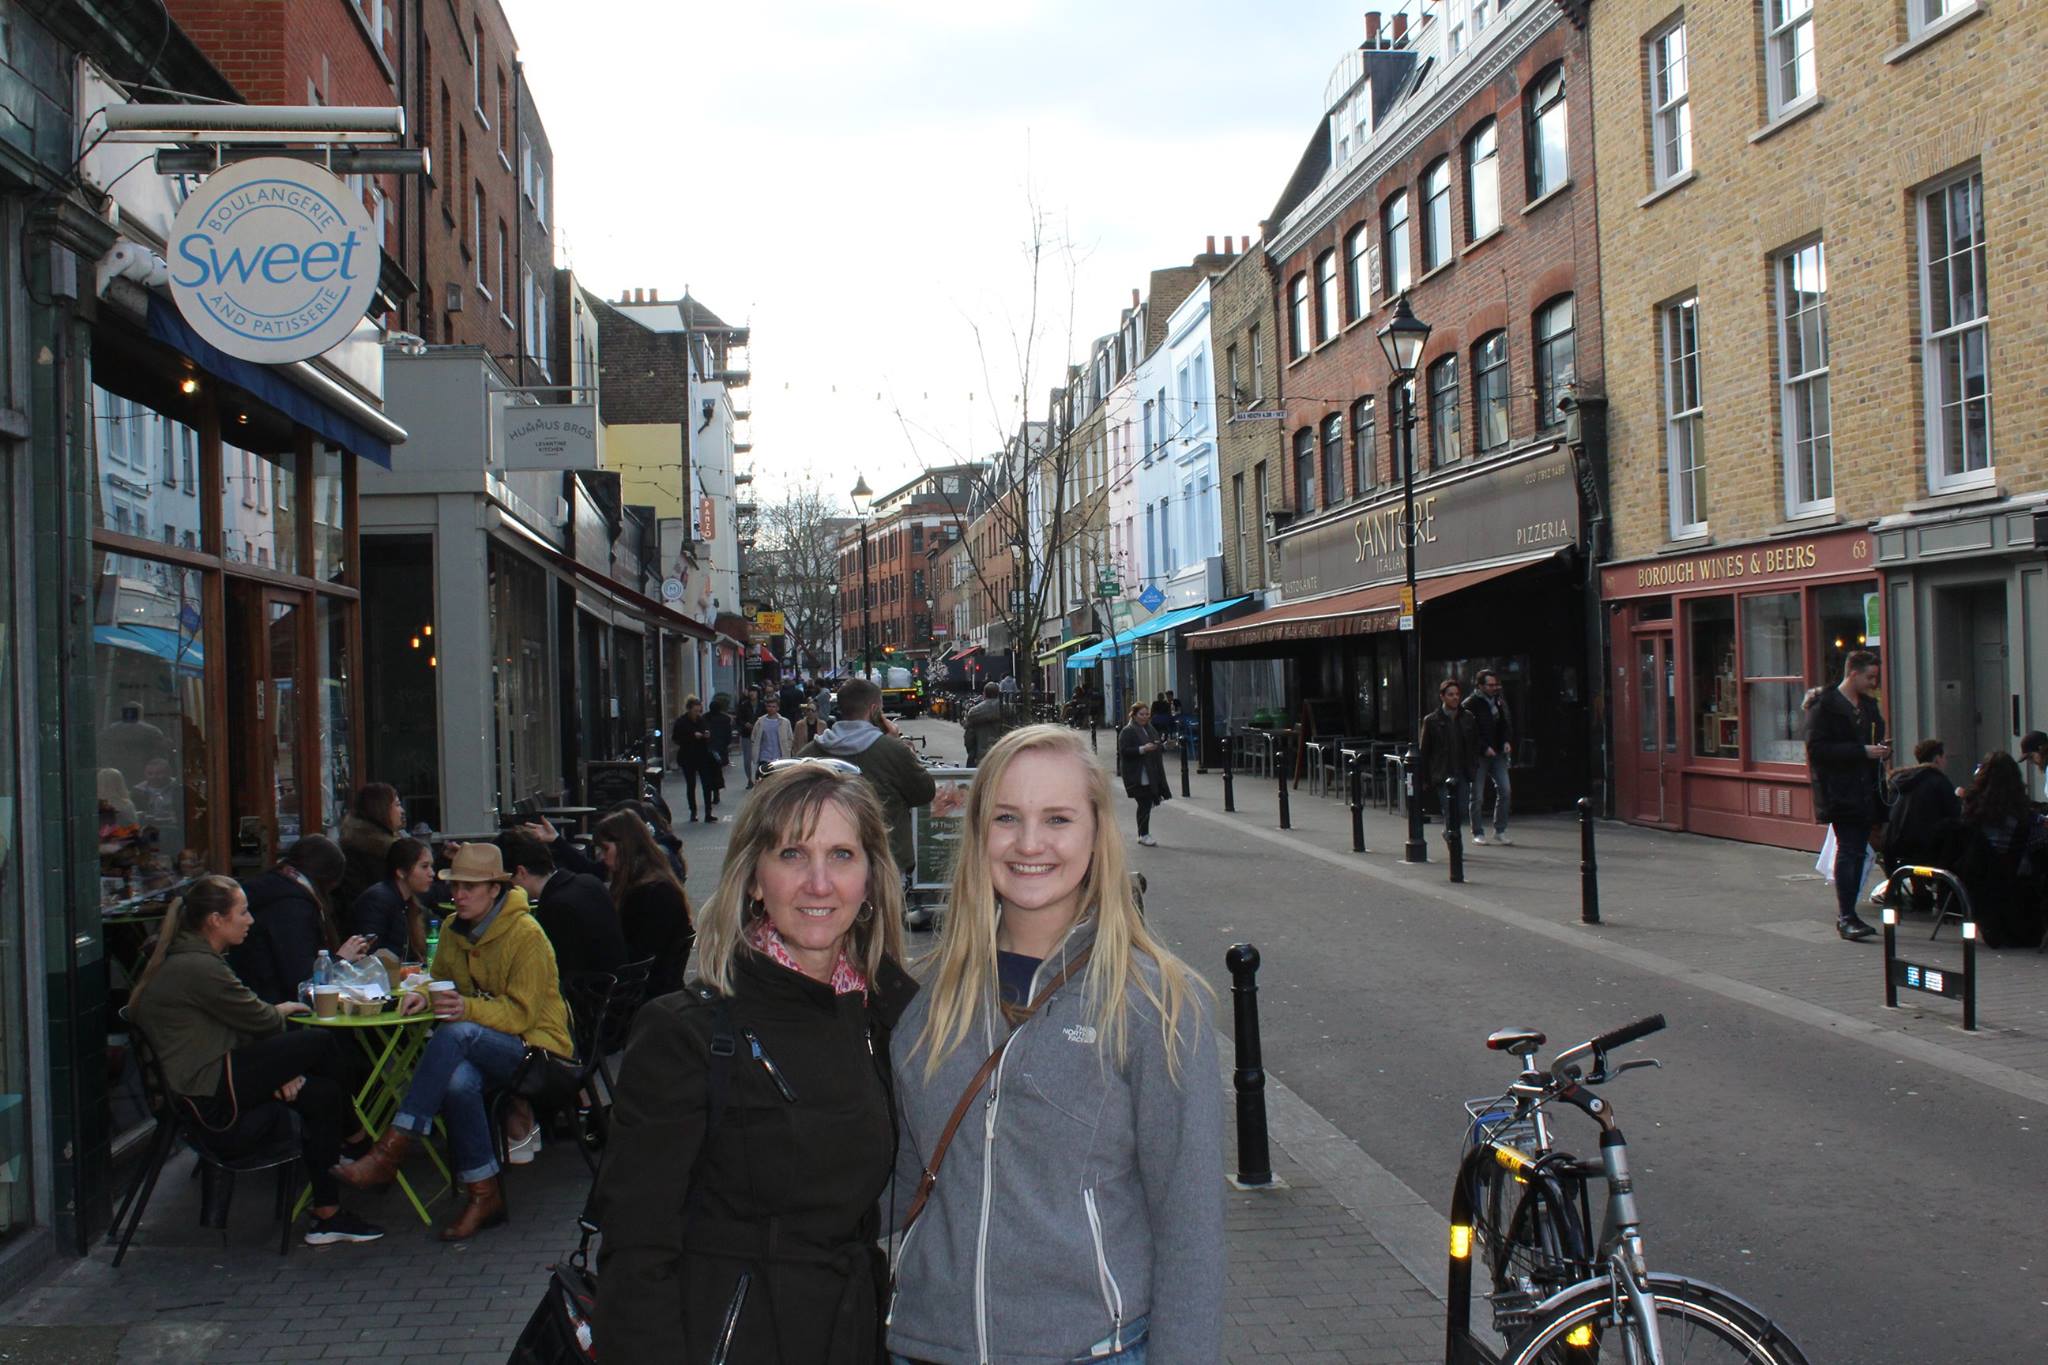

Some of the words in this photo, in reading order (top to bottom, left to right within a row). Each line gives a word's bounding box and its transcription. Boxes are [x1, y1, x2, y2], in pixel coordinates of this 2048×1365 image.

[208, 187, 335, 231] BOULANGERIE
[171, 230, 361, 288] Sweet
[209, 295, 247, 327] AND
[253, 288, 339, 334] PATISSERIE
[508, 419, 560, 440] HUMMUS
[1516, 519, 1568, 545] PIZZERIA
[1851, 540, 1867, 560] 63
[1638, 562, 1695, 588] BOROUGH
[1699, 555, 1744, 580] WINES
[1750, 551, 1763, 575] &
[1766, 544, 1817, 573] BEERS
